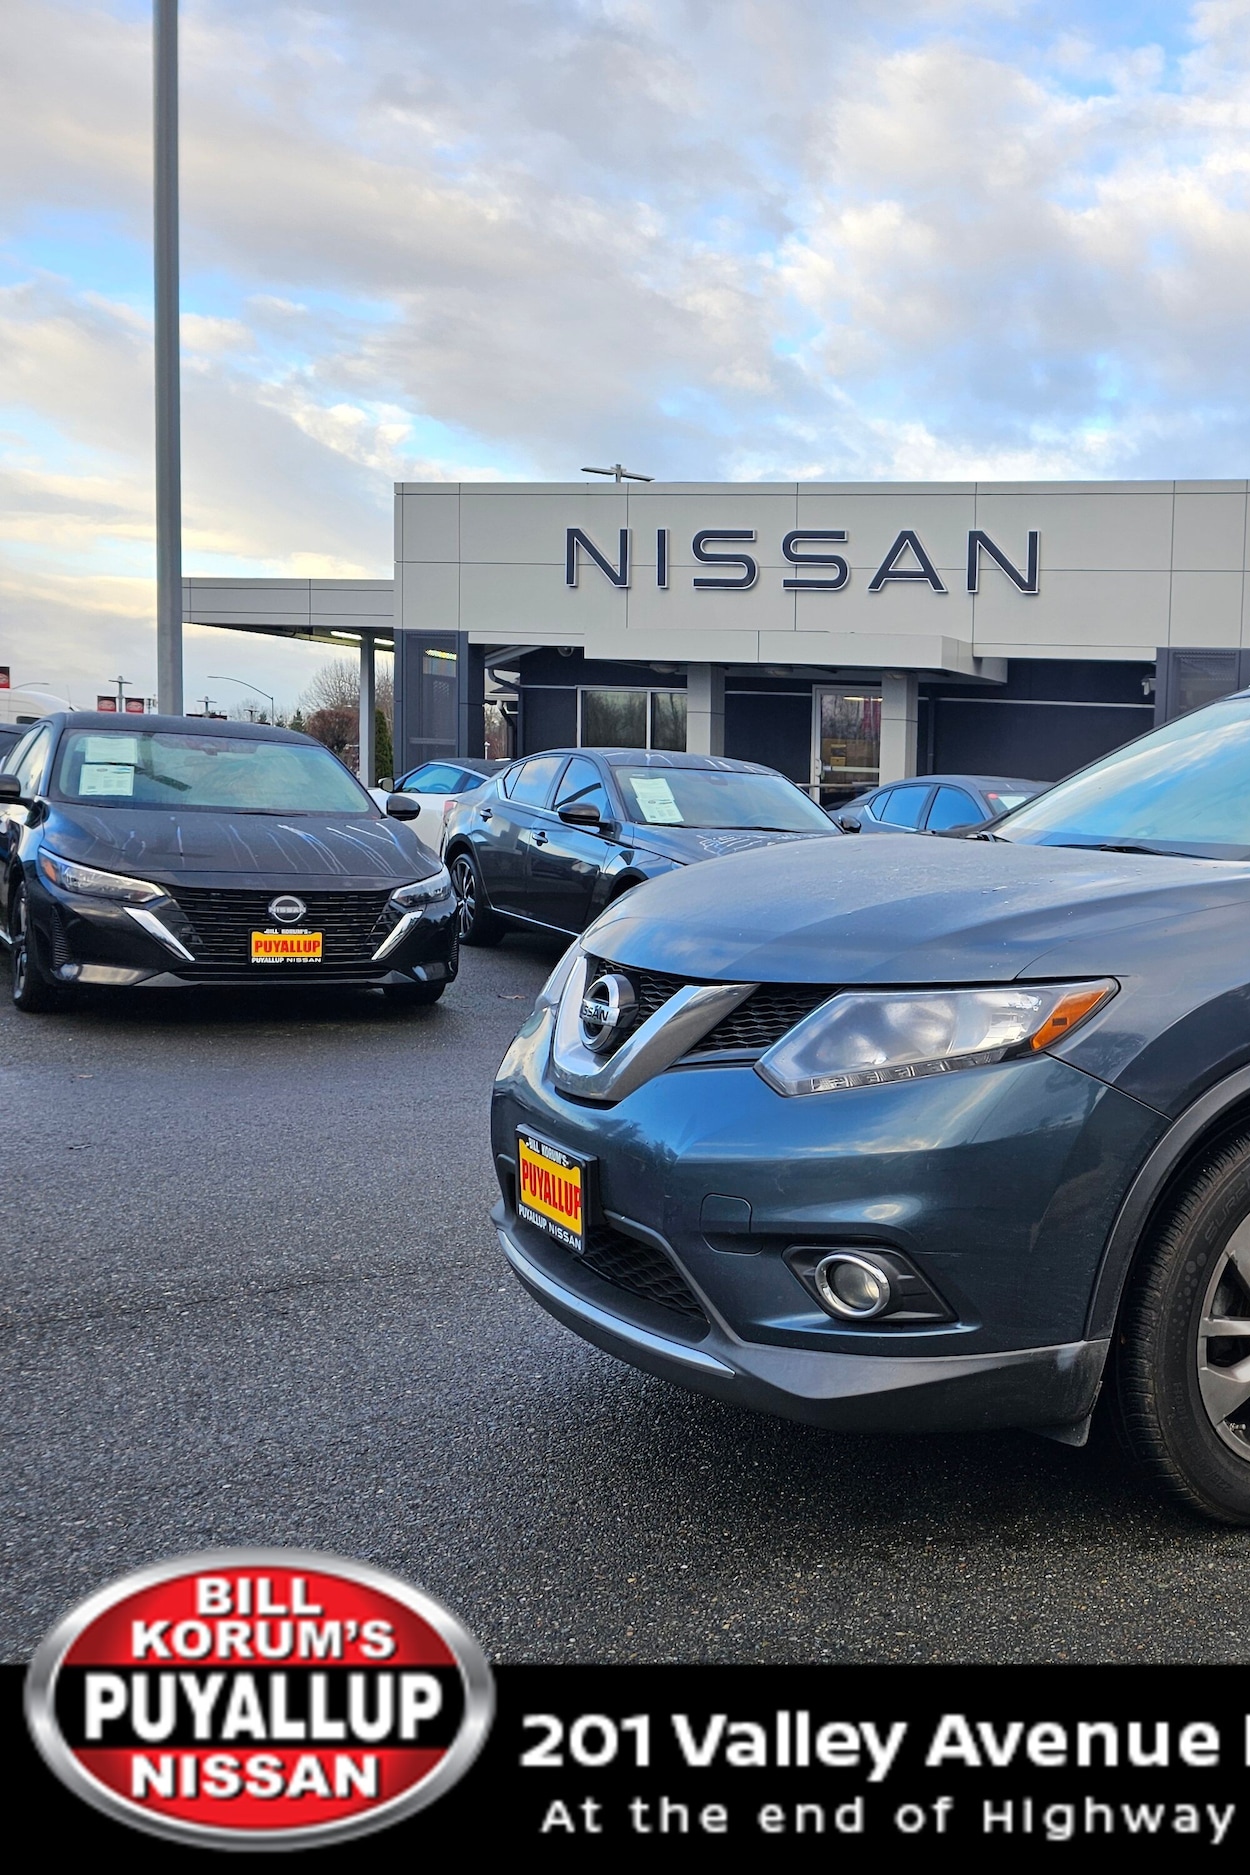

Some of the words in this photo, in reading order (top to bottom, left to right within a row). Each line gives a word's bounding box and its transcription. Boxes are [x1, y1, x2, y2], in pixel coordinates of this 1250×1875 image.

[566, 528, 1040, 593] NISSAN
[268, 906, 306, 914] NISSAN
[254, 940, 321, 953] PUYALLUP
[521, 1158, 582, 1220] PUYALLUP
[518, 1203, 548, 1229] PUYALLUP
[548, 1221, 582, 1251] NISSAN
